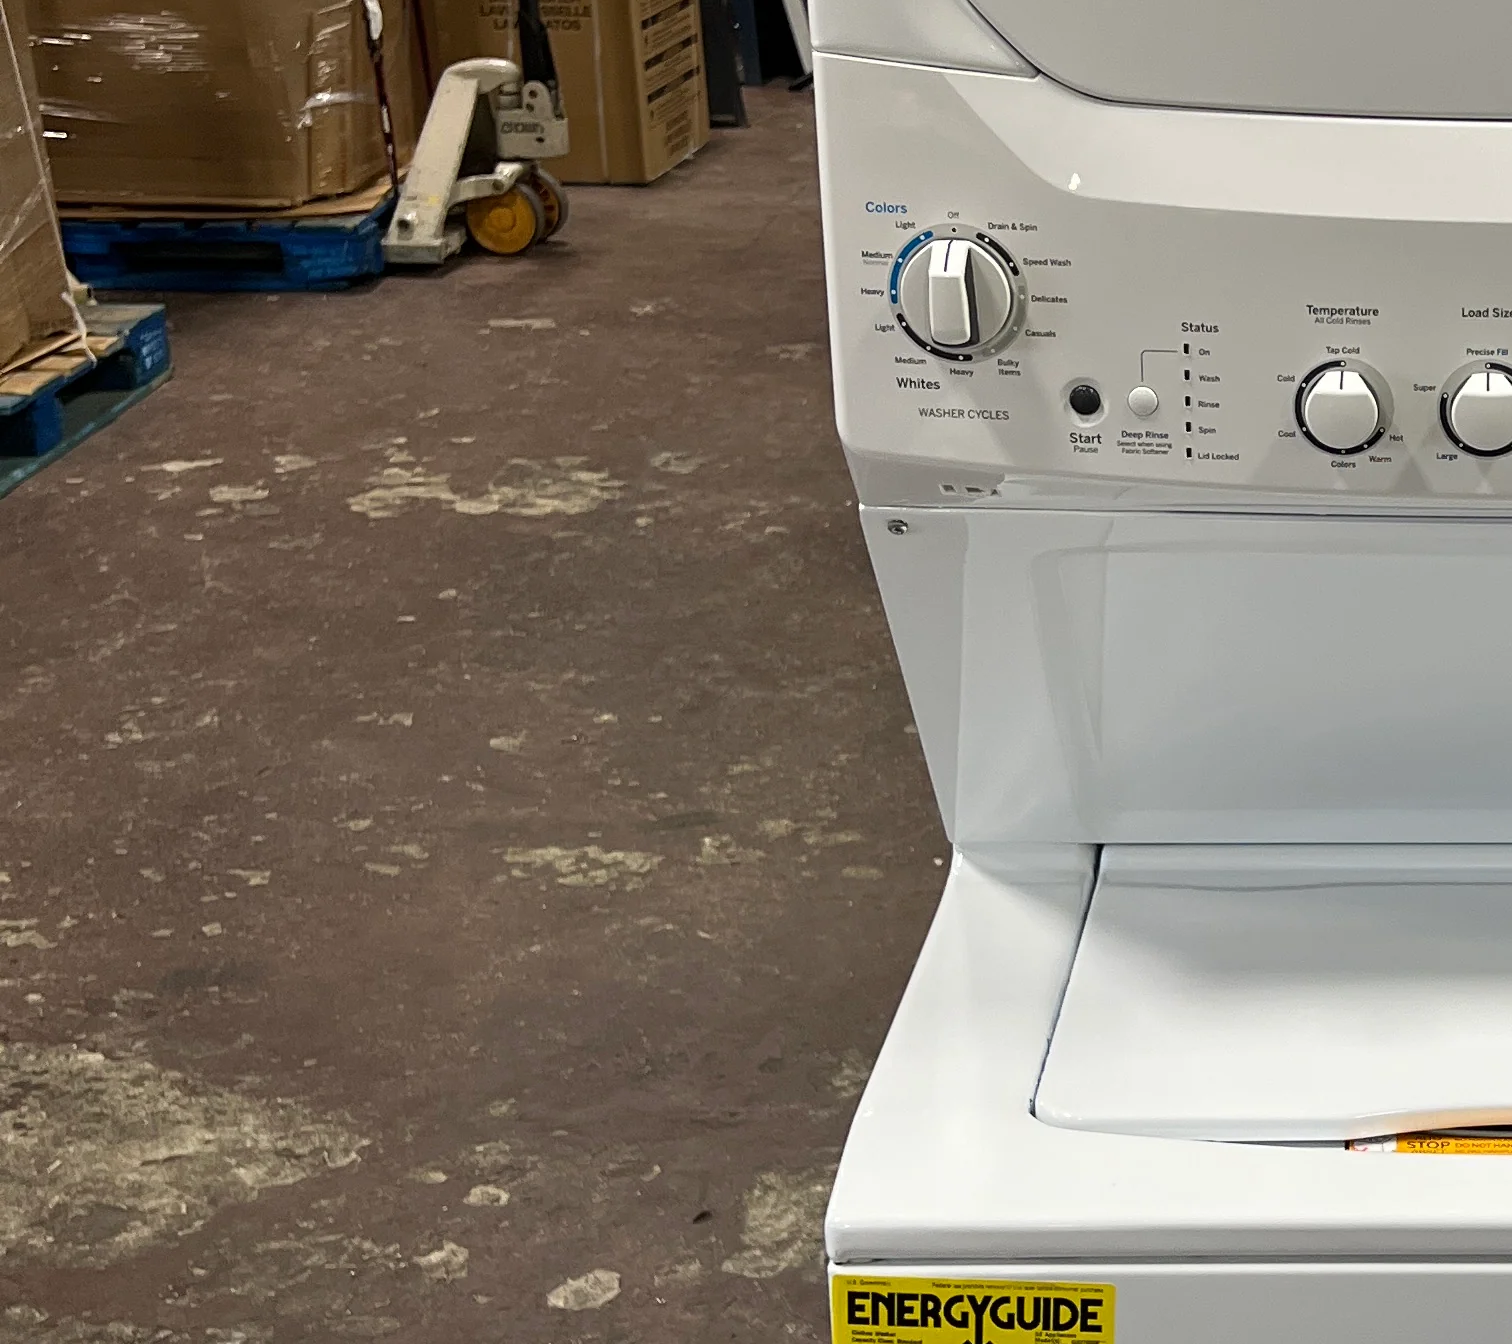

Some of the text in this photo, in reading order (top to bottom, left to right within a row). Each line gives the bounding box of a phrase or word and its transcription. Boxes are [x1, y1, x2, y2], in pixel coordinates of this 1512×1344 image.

[866, 202, 907, 214] Colors
[948, 211, 960, 219] Off
[896, 220, 916, 230] Light
[988, 222, 1038, 232] Drain & Spin
[862, 250, 893, 259] Medium
[1022, 258, 1072, 268] Speed Wash
[860, 288, 884, 297] Heavy
[1030, 294, 1068, 304] Delicates
[1306, 305, 1380, 318] Temperature
[1462, 308, 1490, 318] Load
[1314, 316, 1371, 326] All Cold Rinses
[874, 324, 896, 332] Light
[1181, 322, 1220, 333] Status
[1025, 329, 1056, 338] Casuals
[1198, 348, 1210, 356] On
[1326, 346, 1360, 356] Tap Cold
[1466, 348, 1494, 356] Precise
[894, 356, 927, 365] Medium
[997, 358, 1020, 368] Bulky
[950, 368, 974, 378] Heavy
[1198, 374, 1221, 383] Wash
[1276, 374, 1296, 382] Cold
[896, 376, 941, 390] Whites
[1413, 384, 1436, 393] Super
[1198, 400, 1220, 409] Rinse
[918, 407, 1010, 420] WASHER CYCLES
[1121, 430, 1169, 440] Deep Rinse
[1198, 426, 1216, 435] Spin
[1069, 432, 1102, 444] Start
[1389, 434, 1404, 442] Hot
[1073, 445, 1099, 454] Pause
[1198, 452, 1240, 461] Lid Locked
[1368, 456, 1392, 464] Warm
[1436, 452, 1458, 462] Large
[1330, 460, 1356, 468] Colors
[1406, 1140, 1451, 1148] STOP
[848, 1291, 1103, 1333] ENERGYGUIDE
